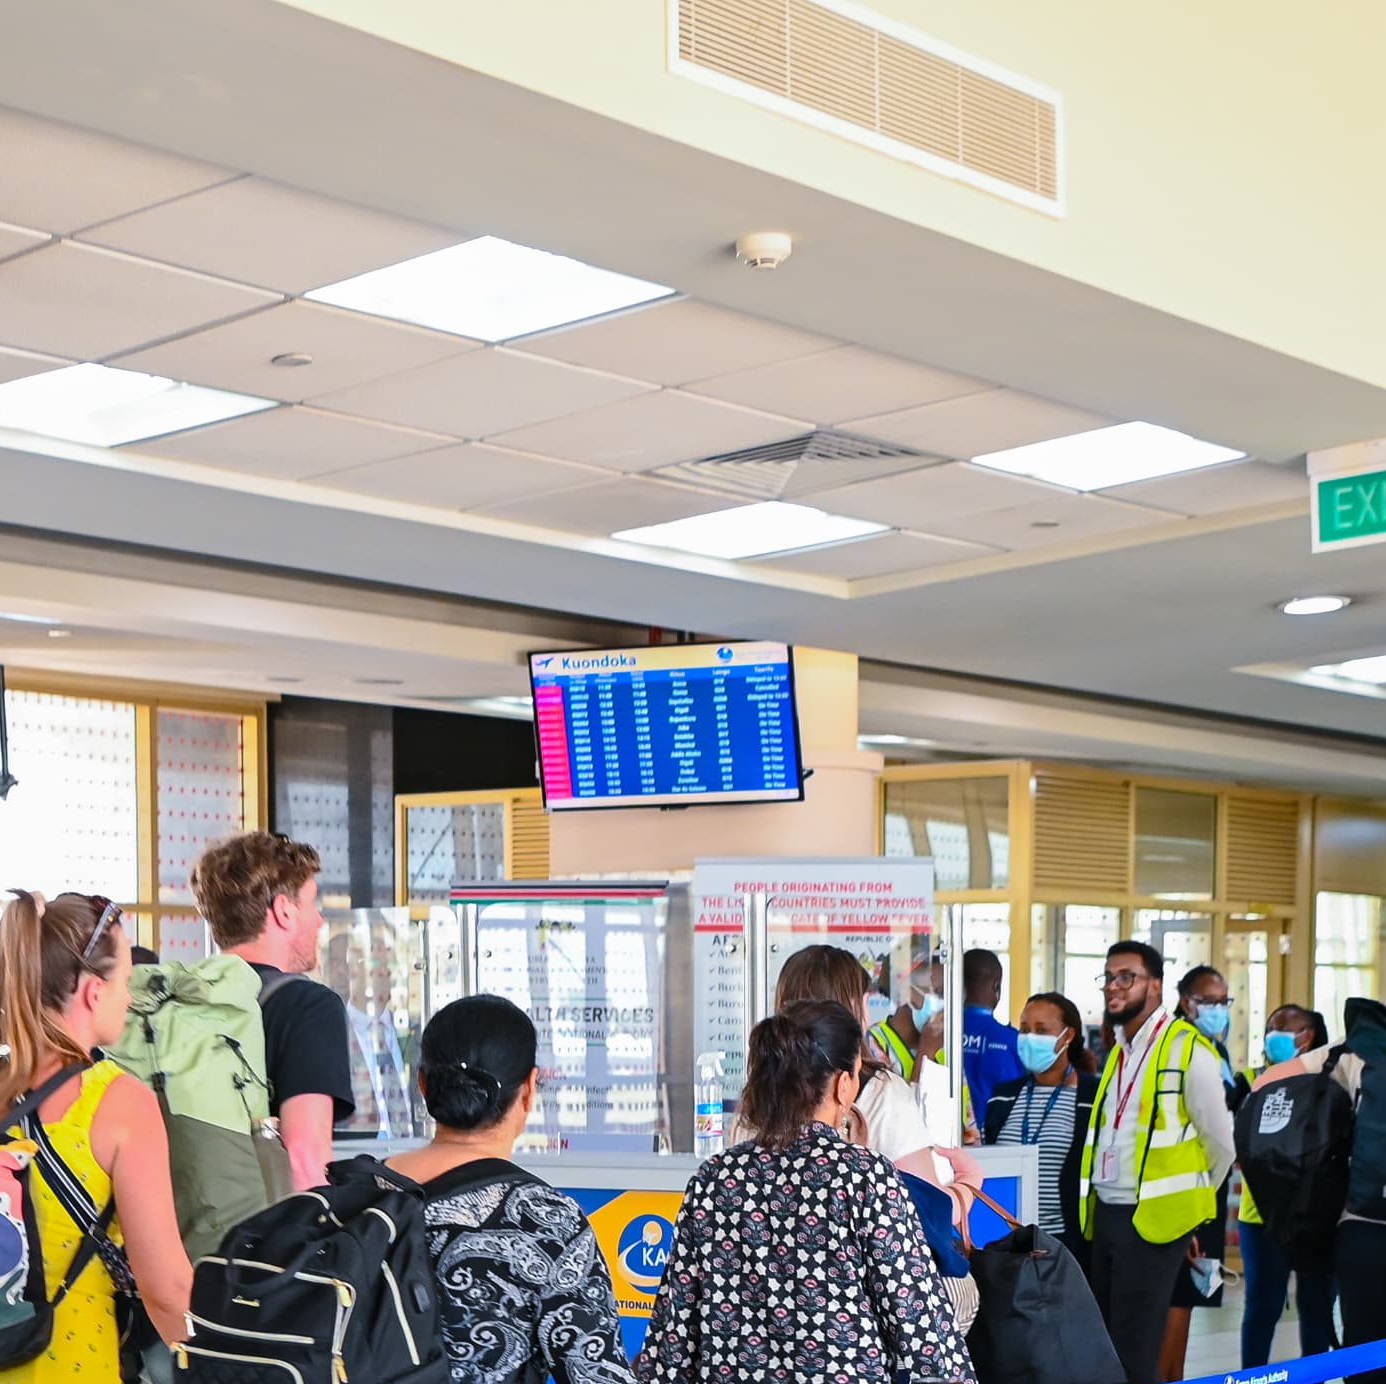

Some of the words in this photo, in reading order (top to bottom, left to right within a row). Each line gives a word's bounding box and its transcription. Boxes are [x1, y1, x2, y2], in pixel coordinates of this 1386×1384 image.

[561, 653, 637, 670] Kuondoka
[733, 881, 778, 893] PEOPLE
[781, 881, 856, 893] ORIGINATING
[859, 881, 893, 893] FROM
[702, 896, 724, 908] THE
[771, 896, 836, 908] COUNTRIES
[840, 896, 871, 908] MUST
[875, 897, 926, 908] PROVIDE
[709, 913, 742, 924] VALID
[841, 913, 888, 924] YELLOW
[571, 1006, 654, 1024] SERVICES
[642, 1247, 670, 1267] KA
